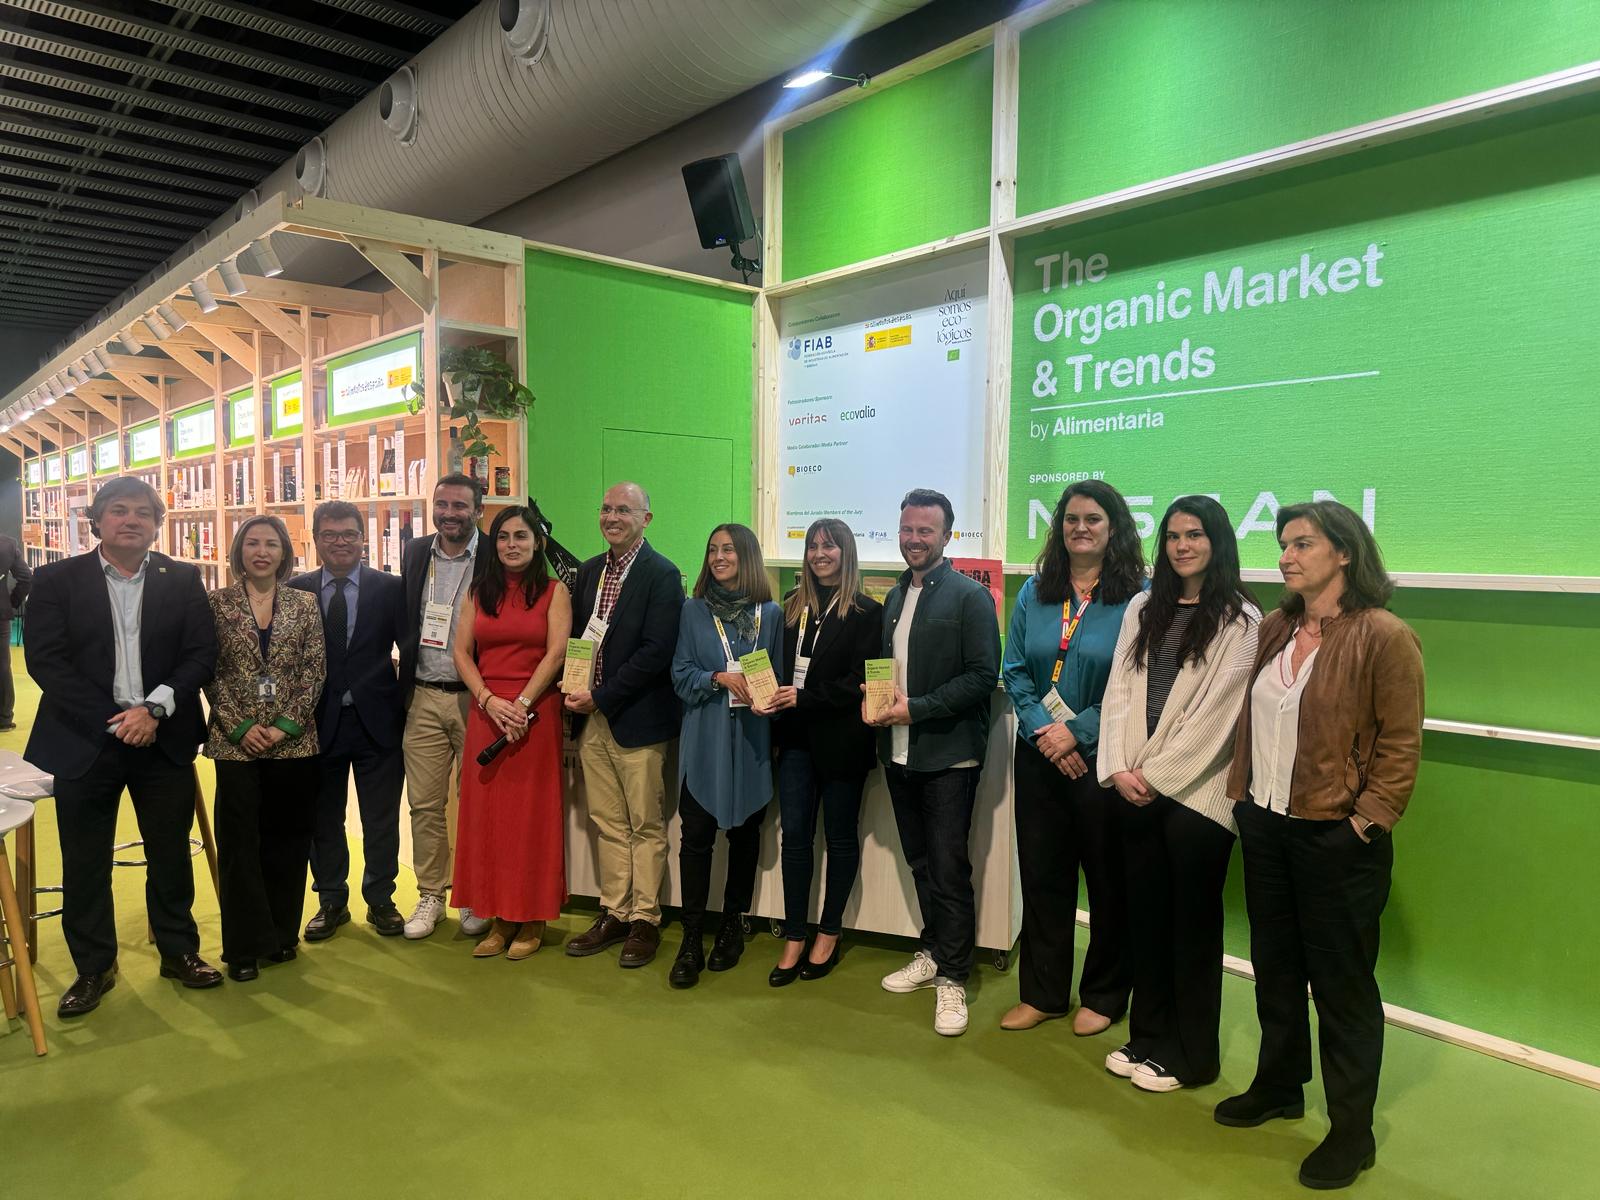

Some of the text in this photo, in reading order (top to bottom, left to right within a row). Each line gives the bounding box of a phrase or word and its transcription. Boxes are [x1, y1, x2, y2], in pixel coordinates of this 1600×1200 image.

[1034, 251, 1109, 294] The
[1033, 243, 1384, 345] Organic Market
[938, 301, 972, 317] somos
[804, 335, 833, 353] FIAB
[936, 328, 972, 346] lógicos
[1032, 338, 1216, 398] & Trends
[788, 413, 828, 426] veritas
[840, 405, 876, 421] ecovalia
[1030, 408, 1165, 441] by Alimentaria
[796, 465, 822, 473] BIOECO
[1029, 470, 1106, 484] SPONSORED BY
